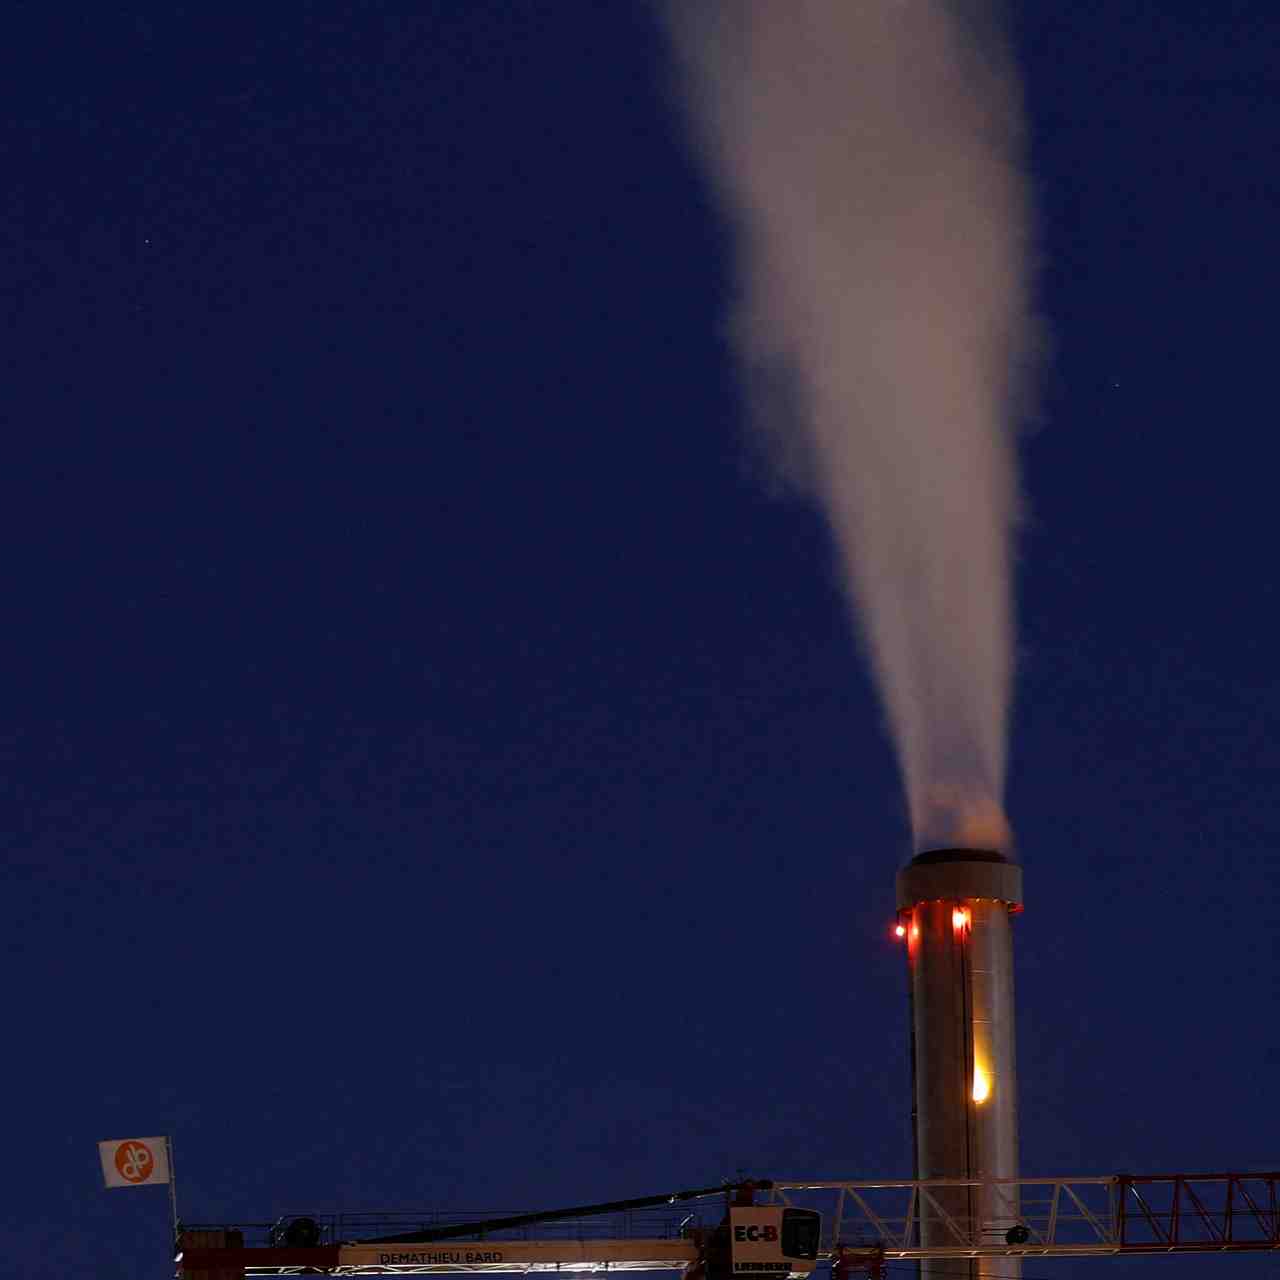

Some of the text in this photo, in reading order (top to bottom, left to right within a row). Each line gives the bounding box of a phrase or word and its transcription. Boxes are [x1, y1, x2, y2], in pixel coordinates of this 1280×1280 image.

[734, 1225, 778, 1242] EC-B
[380, 1251, 504, 1265] DEMATHIEU BARD
